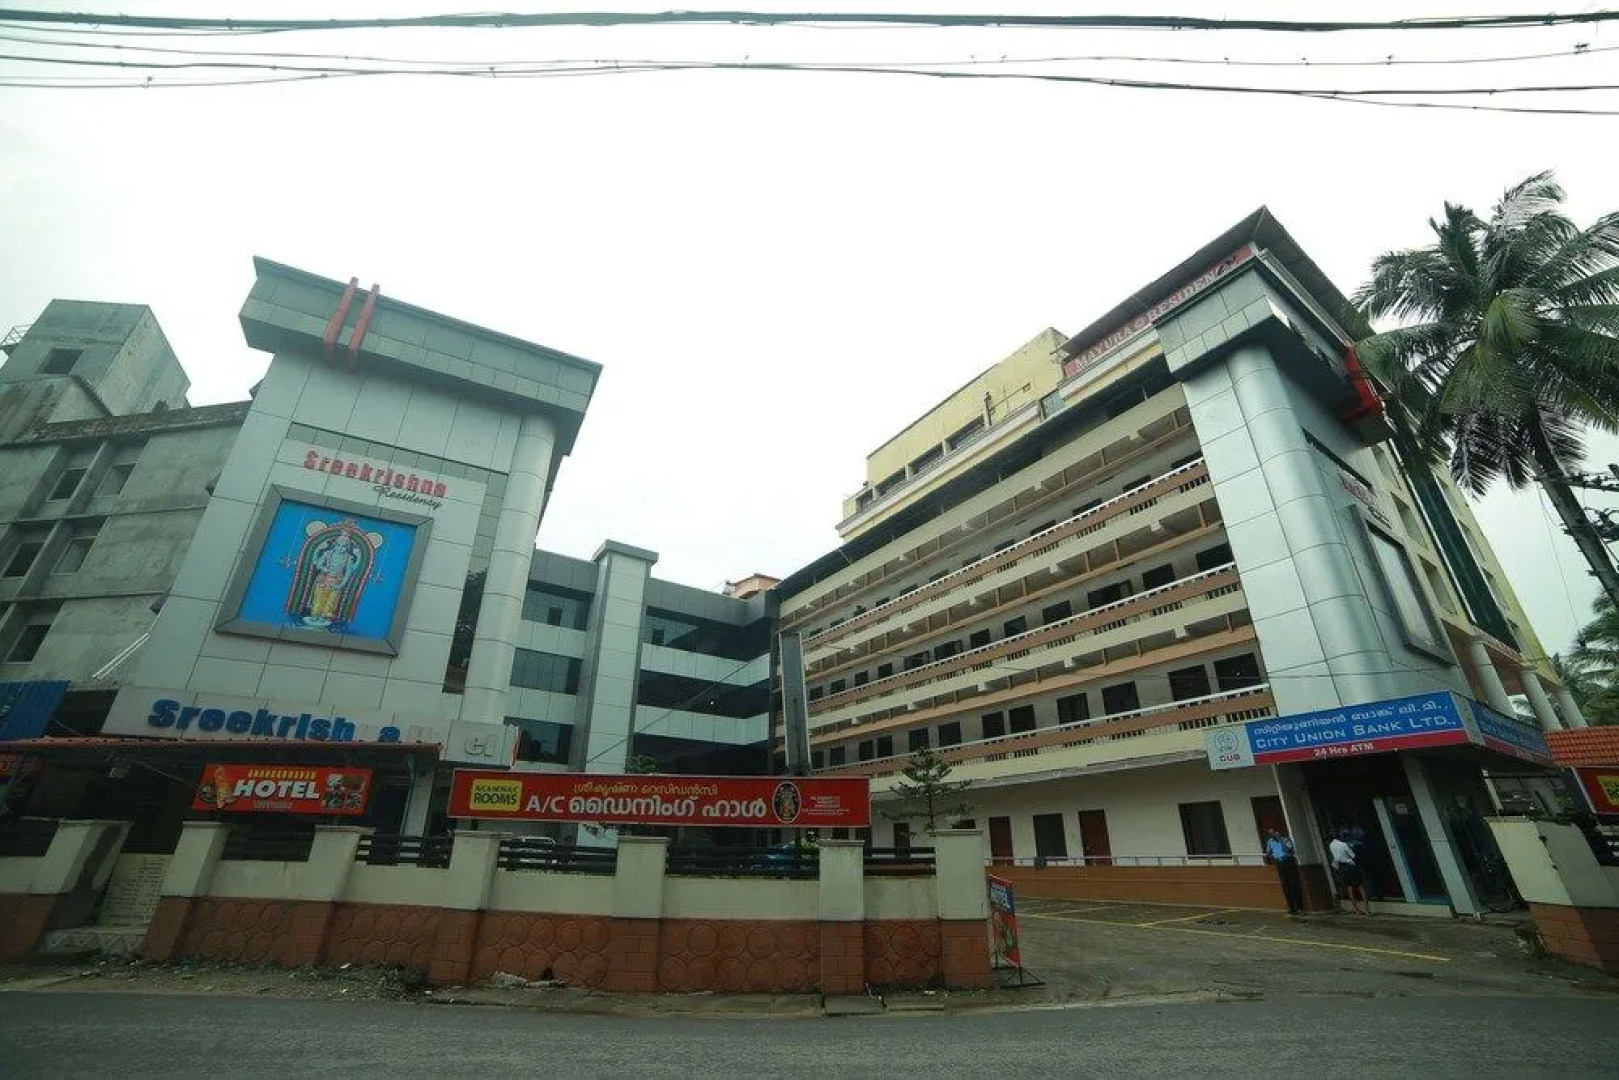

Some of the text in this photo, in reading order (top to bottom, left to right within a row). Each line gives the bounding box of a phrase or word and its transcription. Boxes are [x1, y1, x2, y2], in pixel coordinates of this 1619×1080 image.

[304, 449, 446, 498] Sreekrishna
[373, 485, 442, 510] Residency
[1256, 737, 1288, 749] CITY
[1297, 730, 1346, 744] UNION
[1353, 720, 1400, 736] BANK
[1350, 742, 1374, 752] ATM
[1219, 752, 1241, 762] CUB
[233, 779, 320, 799] HOTEL
[474, 793, 517, 805] ROOMS
[525, 795, 565, 813] A/C
